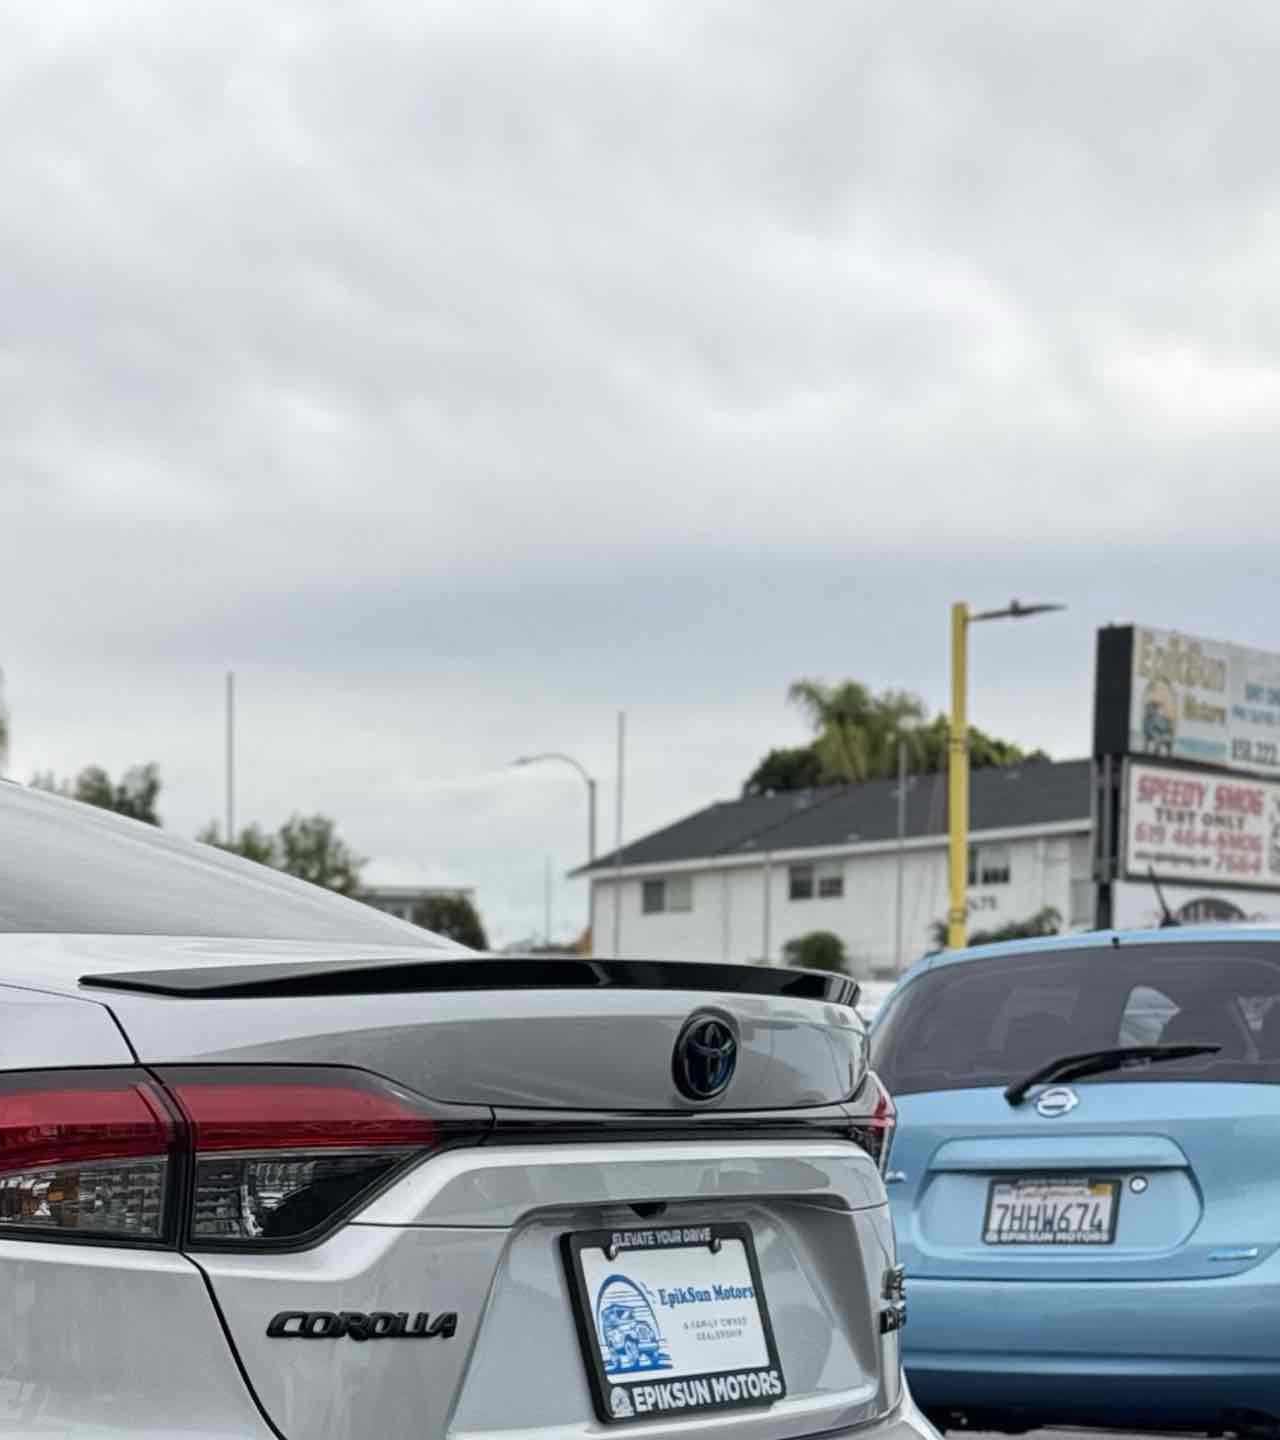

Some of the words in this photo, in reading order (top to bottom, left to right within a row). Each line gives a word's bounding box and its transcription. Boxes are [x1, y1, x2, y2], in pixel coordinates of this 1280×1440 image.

[995, 1202, 1104, 1233] 7HHW674
[612, 1230, 655, 1248] ELEVATE
[656, 1229, 682, 1245] YOUR
[683, 1227, 711, 1242] DRIVE
[657, 1286, 712, 1309] EpikSun
[712, 1283, 754, 1301] Motors
[266, 1310, 459, 1342] COROLLA
[632, 1382, 711, 1413] EPIKSUN
[710, 1370, 782, 1403] MOTORS
